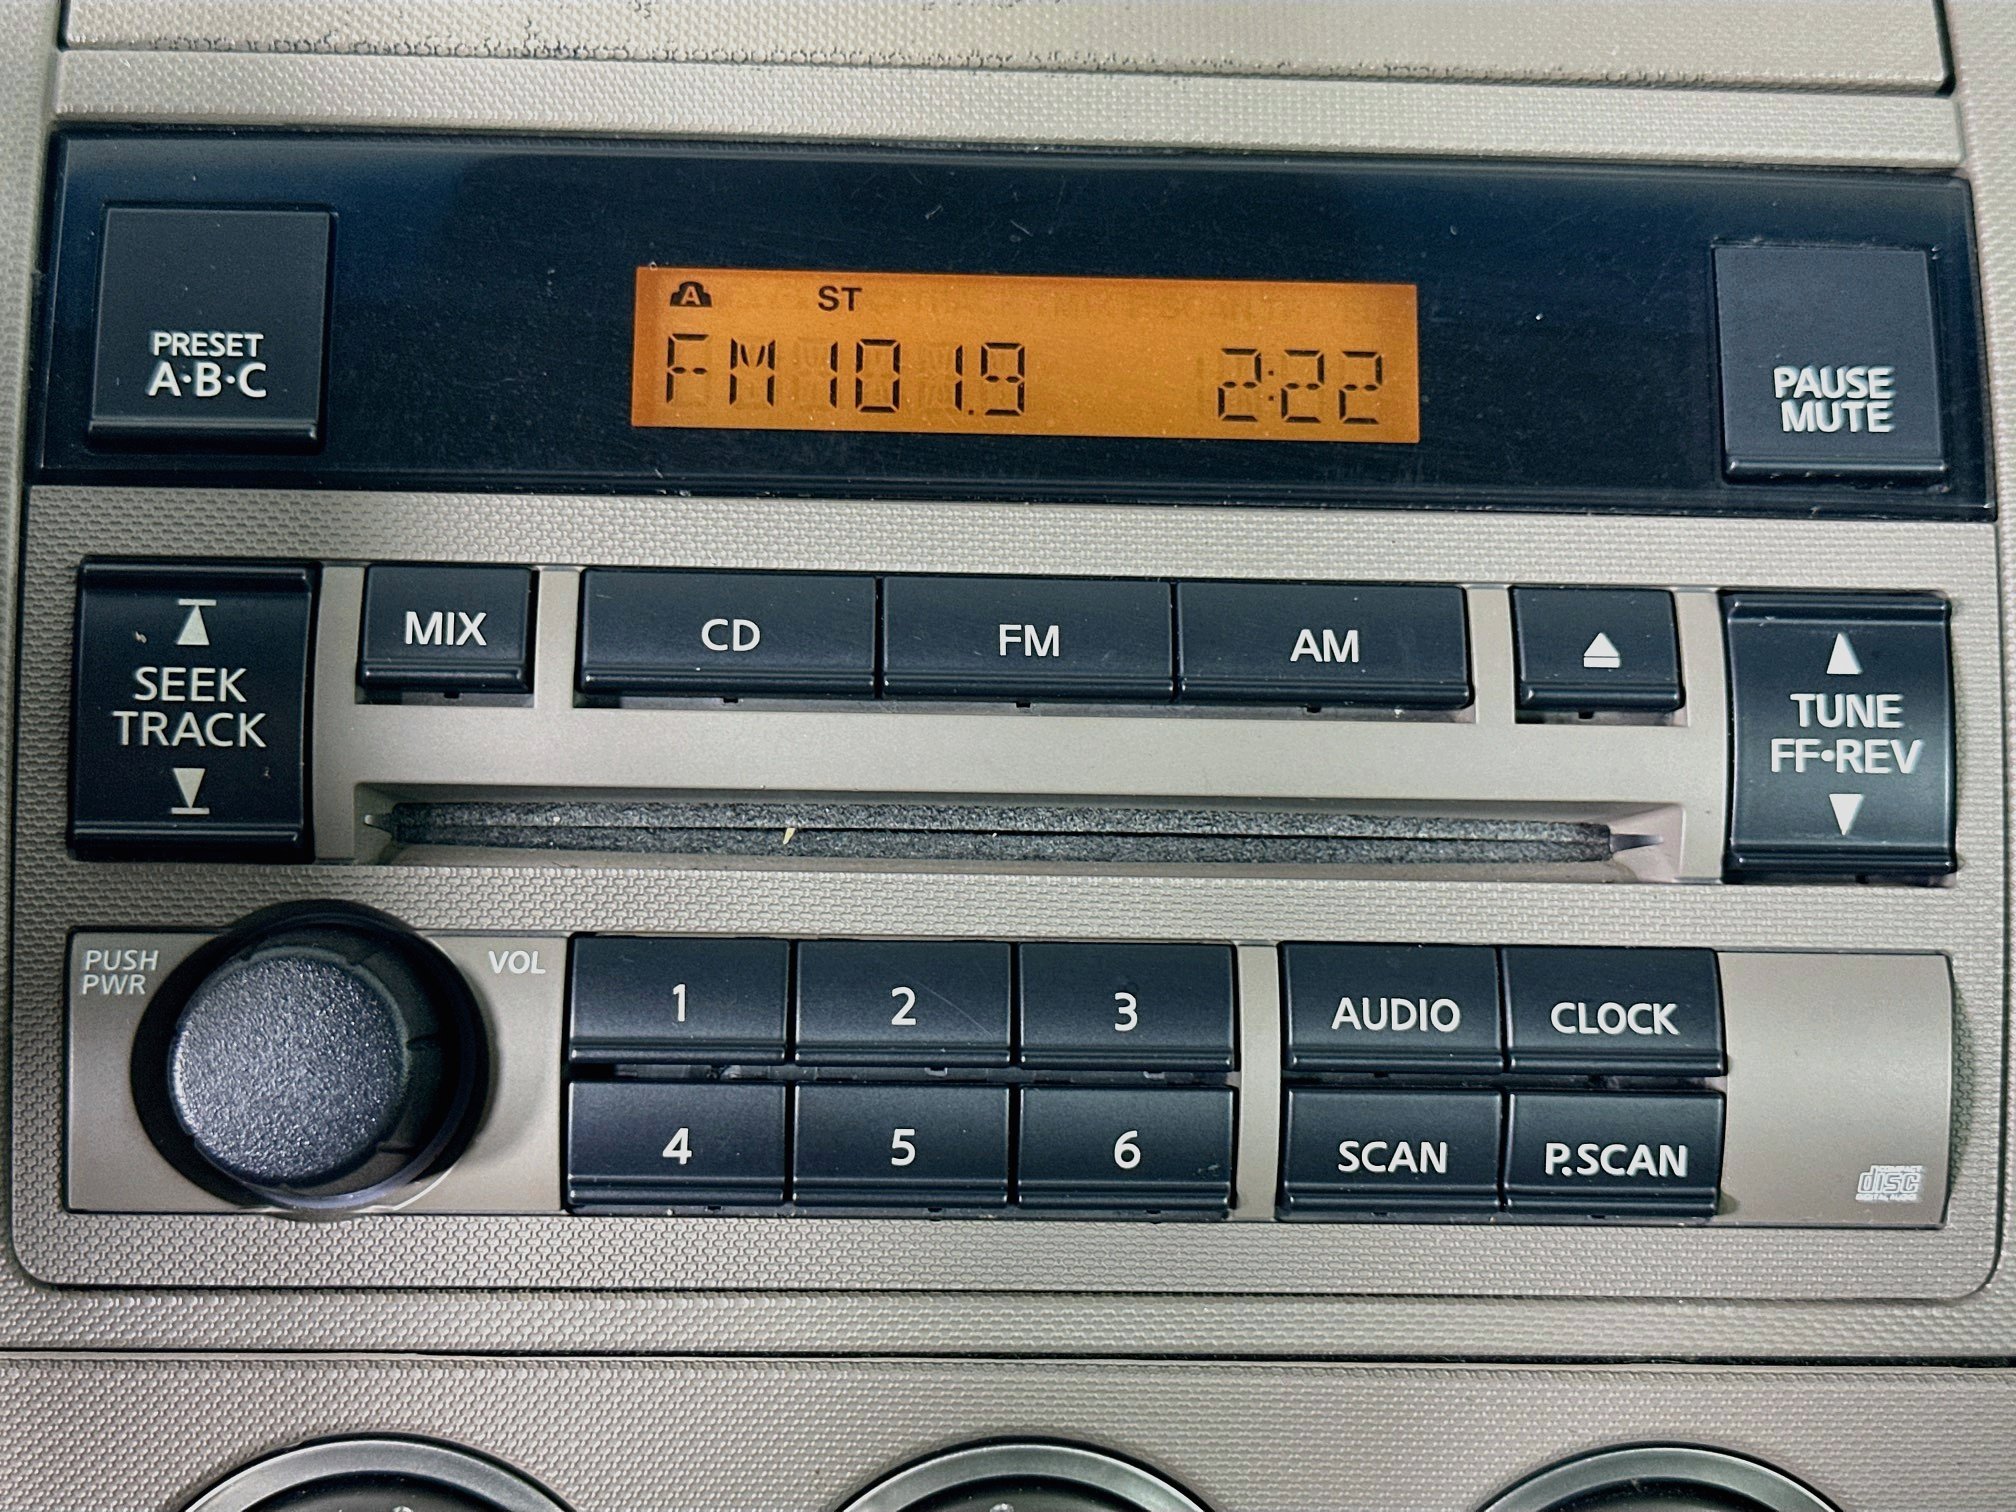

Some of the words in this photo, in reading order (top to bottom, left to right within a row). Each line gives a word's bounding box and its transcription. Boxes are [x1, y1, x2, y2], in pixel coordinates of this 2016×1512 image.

[817, 285, 863, 312] ST
[153, 331, 264, 358] PRESET
[1218, 347, 1384, 424] 2:22
[1773, 365, 1895, 399] PAUSE
[1781, 400, 1894, 433] MUTE
[405, 611, 487, 646] MIX
[701, 618, 761, 652] CD
[999, 624, 1060, 657] FM
[1289, 628, 1359, 663] AM
[134, 666, 247, 703] SEEK
[1789, 693, 1904, 729] TUNE
[112, 710, 267, 748] TRACK
[84, 949, 159, 971] PUSH
[488, 950, 547, 975] VOL
[81, 974, 146, 995] PWR
[672, 983, 686, 1022] 1
[891, 986, 917, 1026] 2
[1114, 992, 1138, 1032] 3
[1331, 997, 1461, 1033] AUDIO
[1550, 1002, 1680, 1036] CLOCK
[662, 1127, 693, 1165] 4
[891, 1128, 916, 1166] 5
[1114, 1130, 1141, 1169] 6
[1338, 1140, 1448, 1174] SCAN
[1545, 1142, 1688, 1177] P.SCAN
